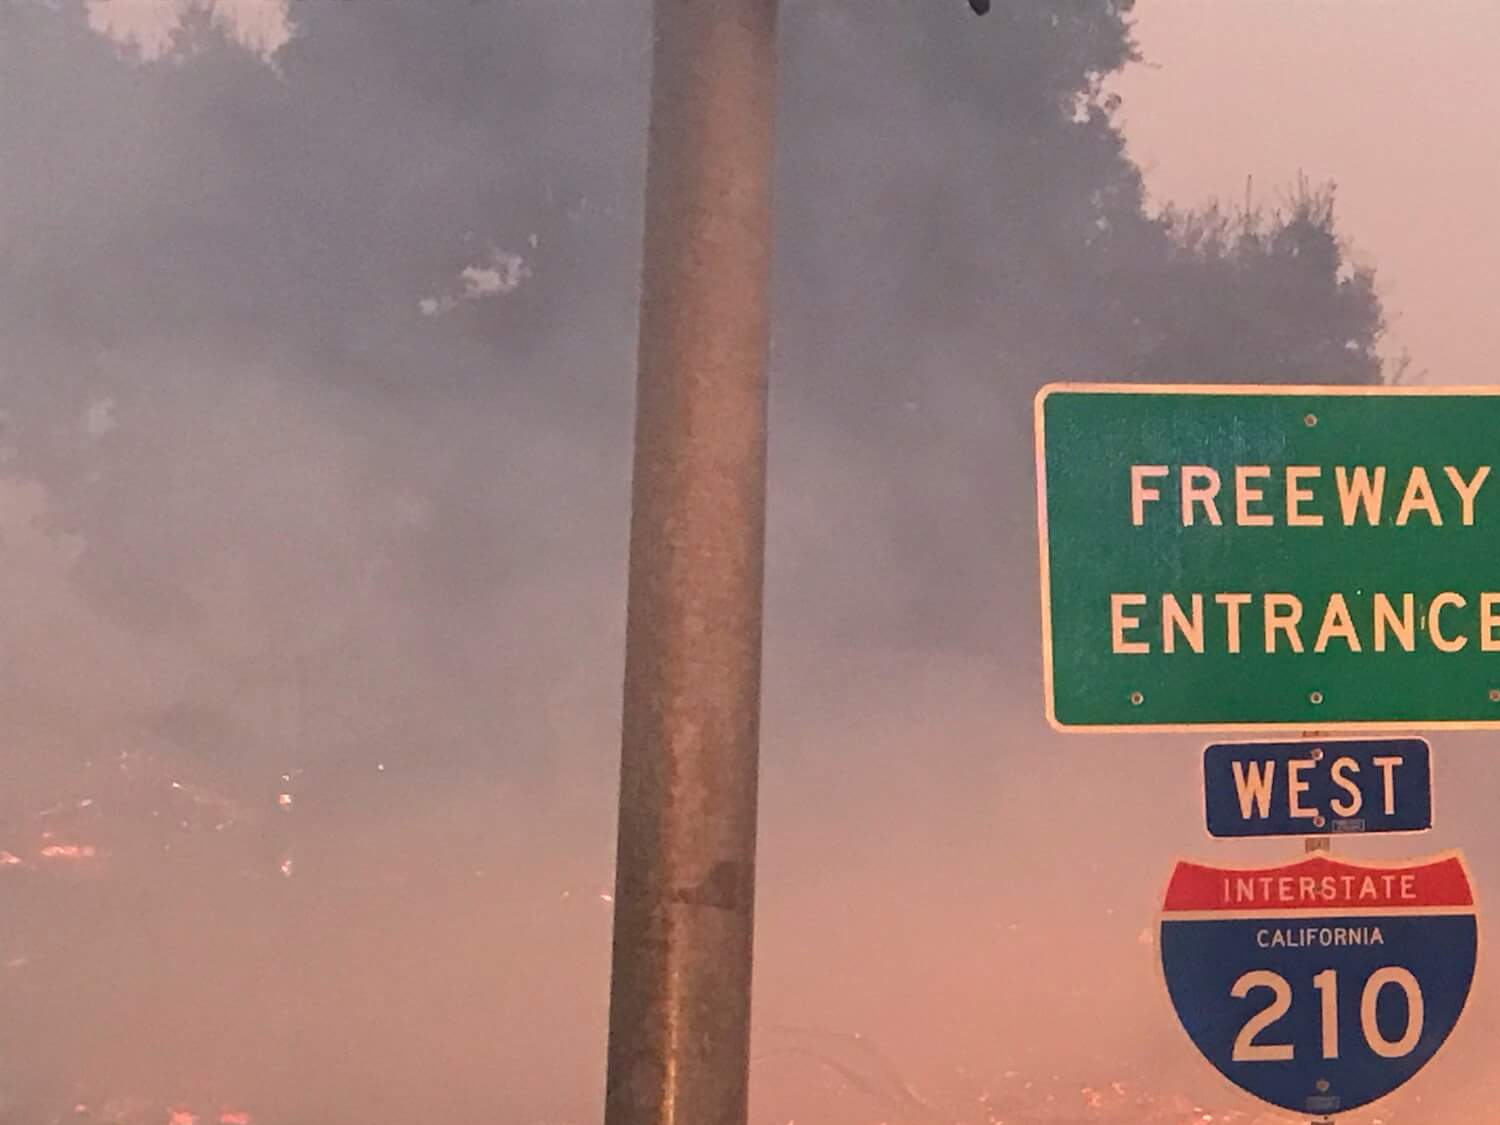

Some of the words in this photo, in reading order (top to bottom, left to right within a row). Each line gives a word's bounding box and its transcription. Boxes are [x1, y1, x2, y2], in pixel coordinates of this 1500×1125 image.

[1129, 464, 1491, 527] FREEWAY
[1231, 756, 1403, 820] WEST
[1223, 874, 1417, 903] INTERSTATE
[1256, 927, 1384, 948] CALIFORNIA
[1230, 966, 1425, 1062] 210
